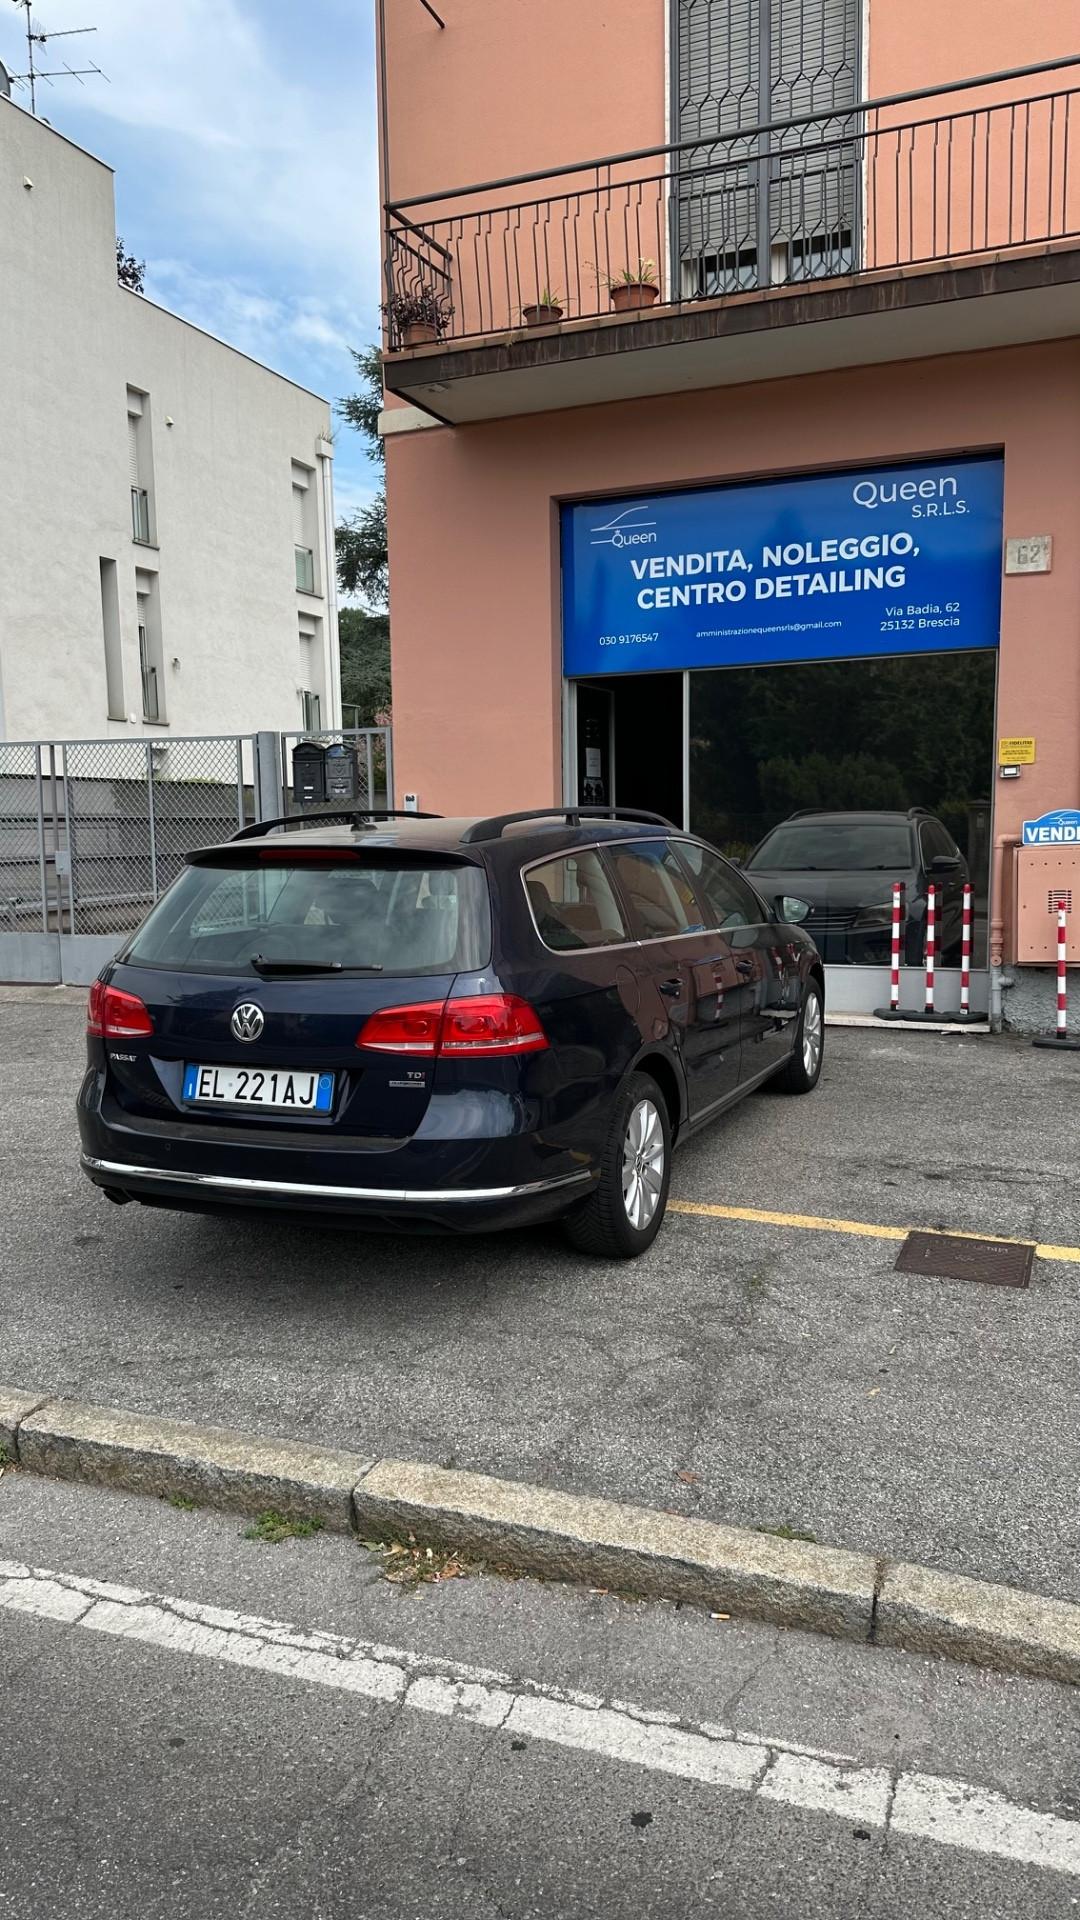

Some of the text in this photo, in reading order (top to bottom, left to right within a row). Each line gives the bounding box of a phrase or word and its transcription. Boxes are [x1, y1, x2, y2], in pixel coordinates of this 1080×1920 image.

[852, 476, 957, 509] Queen
[911, 500, 970, 519] S.R.L.S.
[611, 532, 657, 549] Queen
[630, 531, 920, 580] VENDITA, NOLEGGIO,
[637, 565, 906, 610] CENTRO DETAILING
[885, 602, 960, 617] Via Badia, 62
[696, 620, 842, 638] amministrazionequeensrls@gmail.com
[880, 616, 960, 631] 25132 Brescia
[599, 632, 659, 646] 030 9176547
[198, 1069, 316, 1105] EL 221AJ
